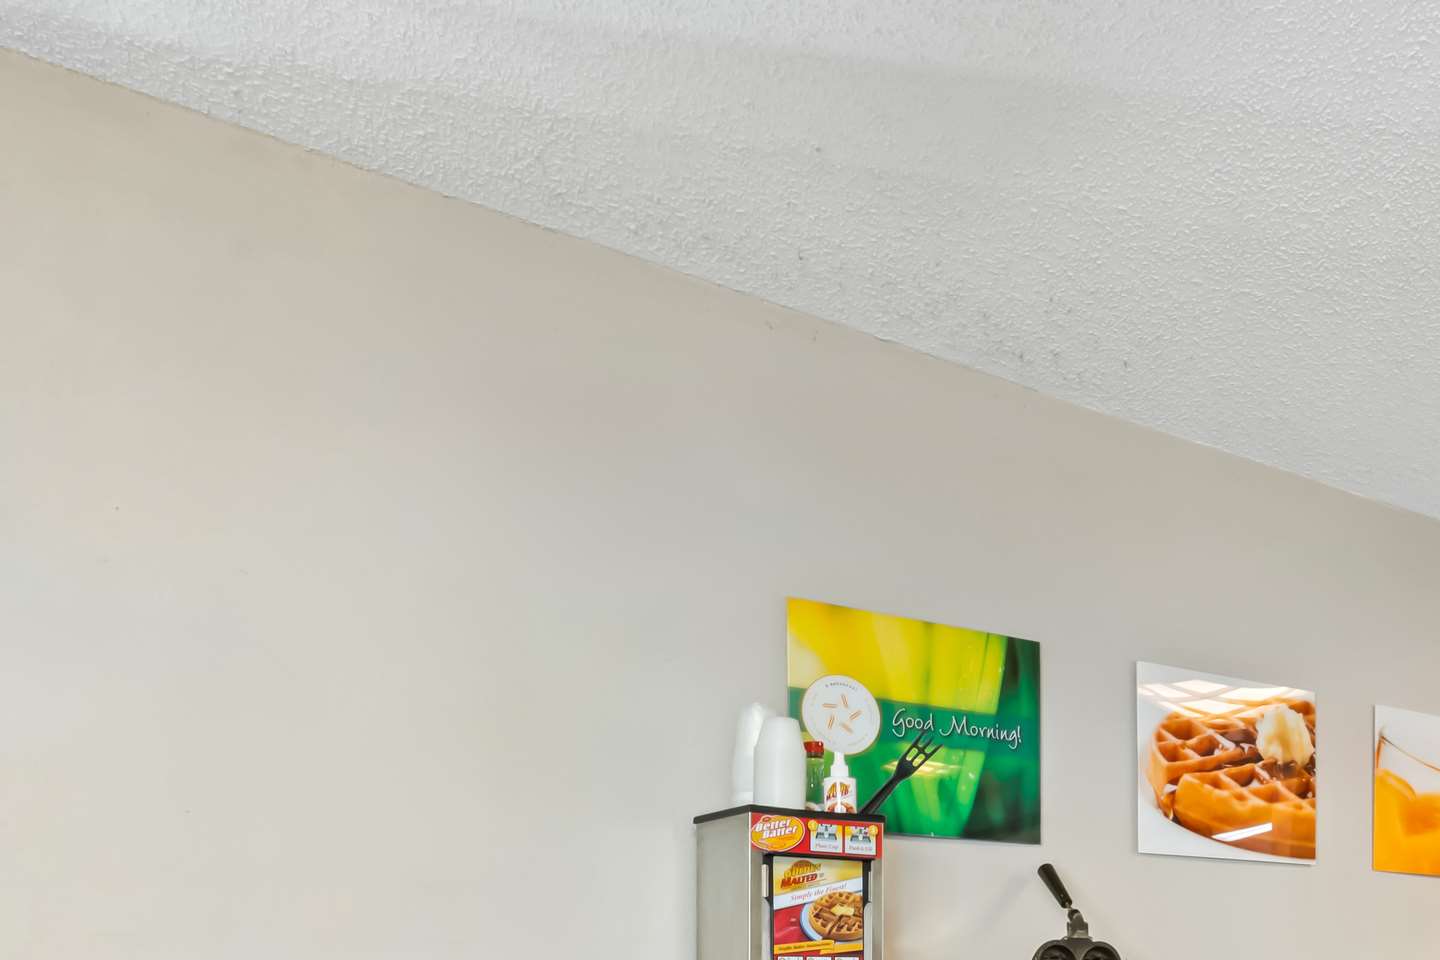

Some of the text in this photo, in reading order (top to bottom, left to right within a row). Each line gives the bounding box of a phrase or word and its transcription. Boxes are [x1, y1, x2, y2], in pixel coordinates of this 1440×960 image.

[892, 708, 1022, 749] Good Morning!
[781, 873, 818, 889] MALTED
